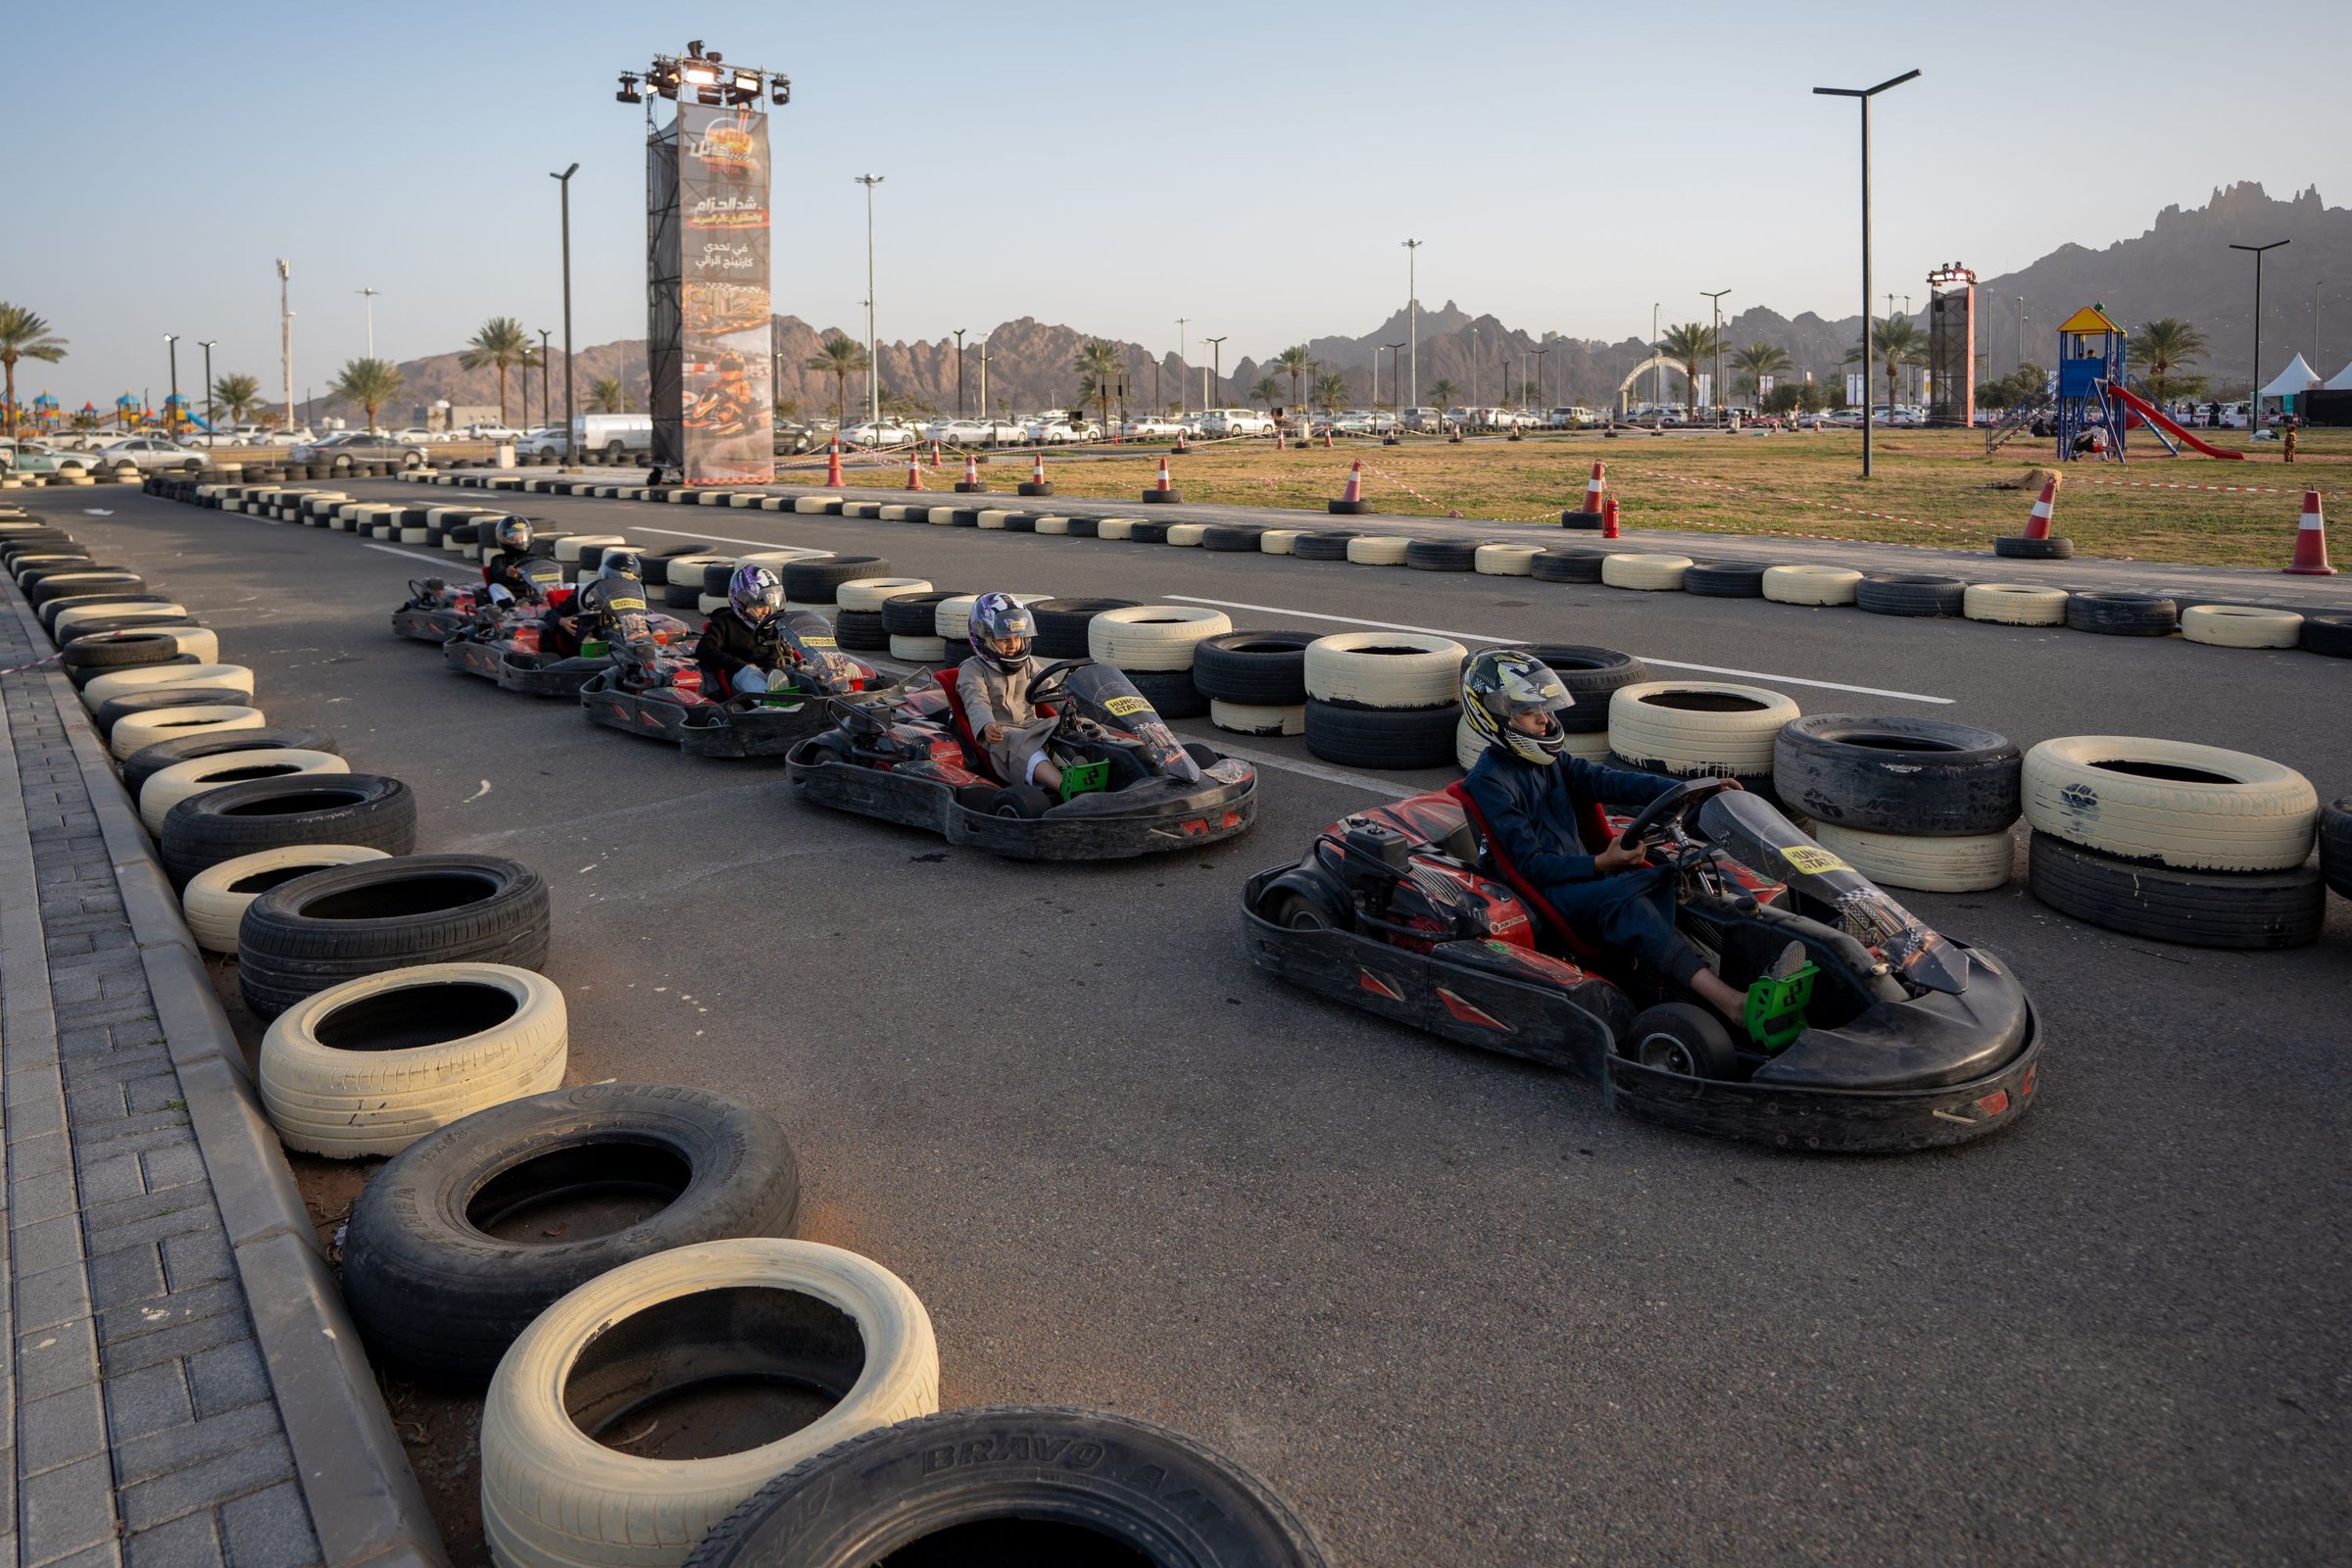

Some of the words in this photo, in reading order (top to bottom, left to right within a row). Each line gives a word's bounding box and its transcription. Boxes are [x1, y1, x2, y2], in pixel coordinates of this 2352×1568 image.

[694, 196, 737, 215] الحزام
[736, 196, 758, 211] شد
[703, 242, 731, 255] تحدي
[732, 243, 748, 257] في
[921, 1435, 1106, 1477] BRAVO
